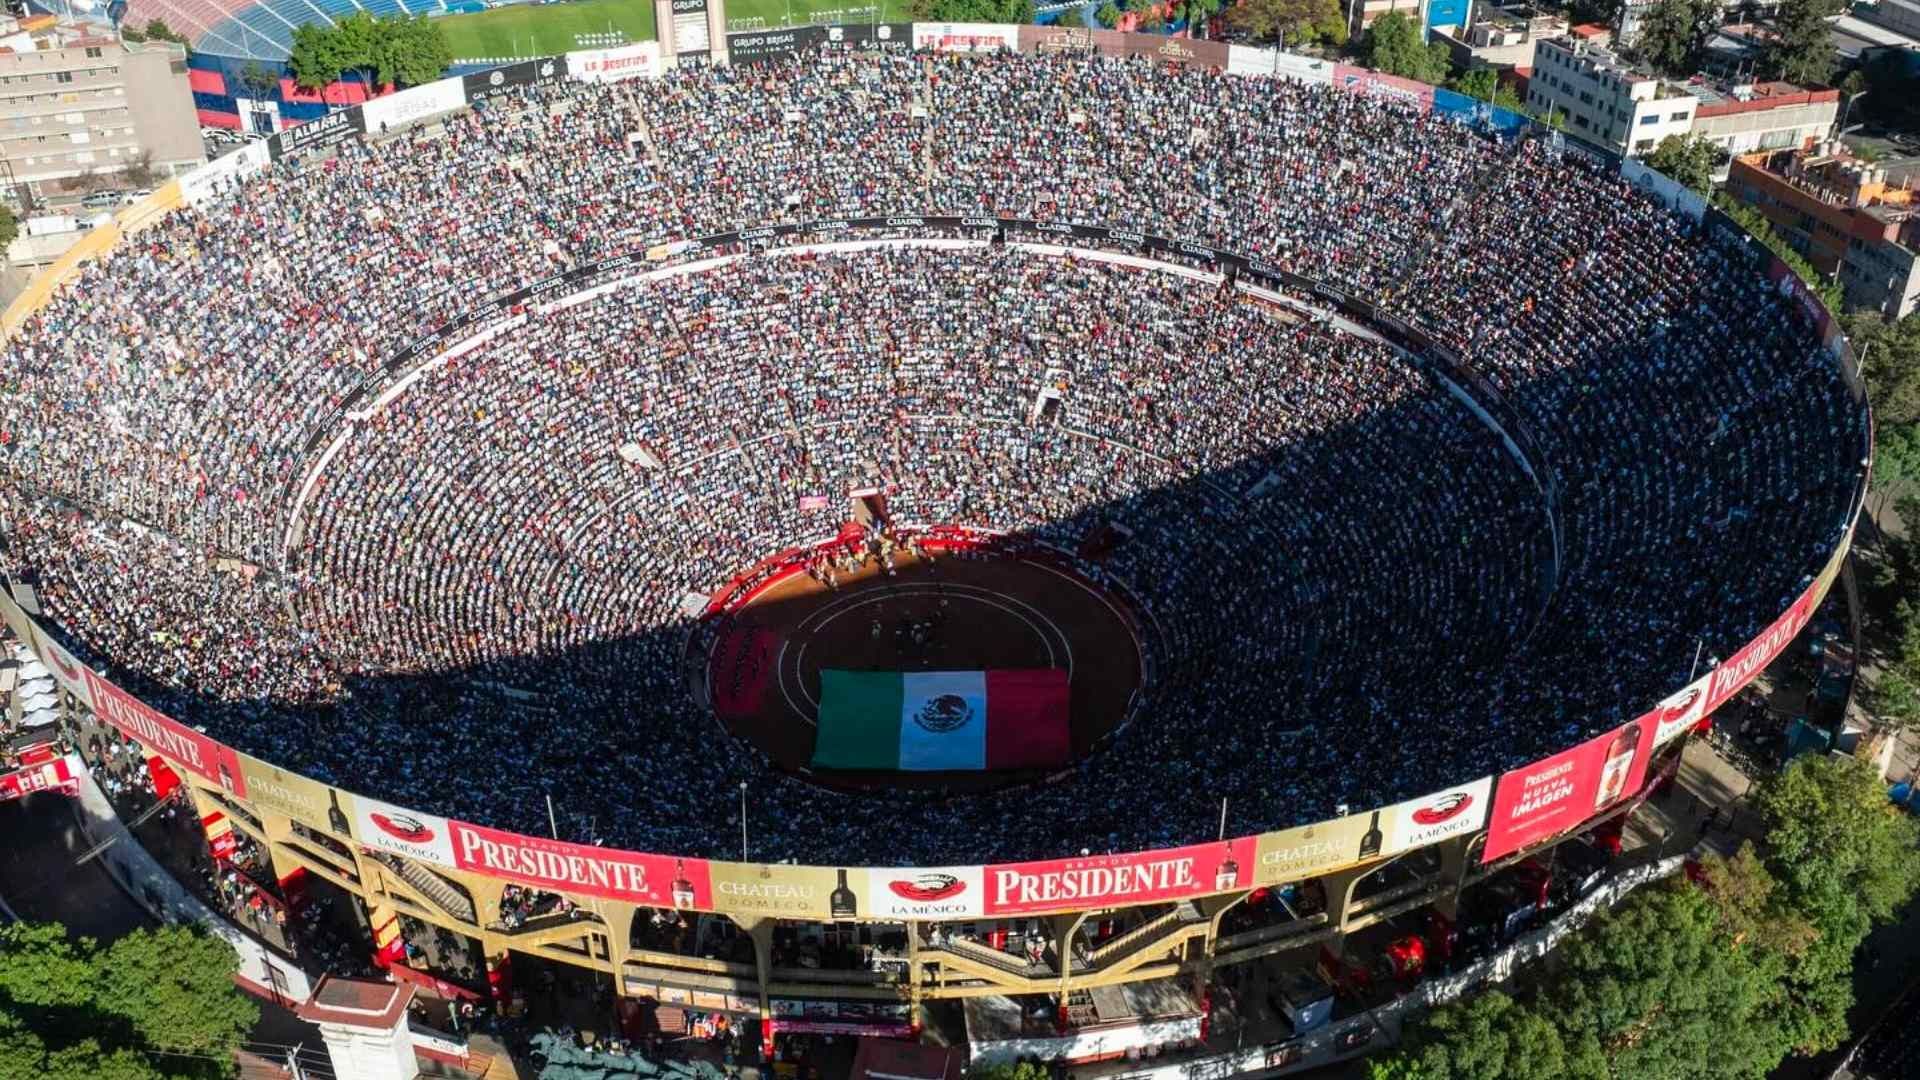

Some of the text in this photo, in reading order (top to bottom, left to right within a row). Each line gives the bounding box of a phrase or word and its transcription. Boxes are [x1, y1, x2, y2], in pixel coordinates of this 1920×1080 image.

[673, 0, 704, 10] GRUPO
[734, 33, 795, 48] GRUPO BRISAS
[294, 111, 350, 140] ALMARA
[886, 218, 925, 227] CUADRA
[91, 677, 204, 769] PRESIDENTE
[1524, 760, 1574, 786] PRESIDENTE
[1511, 784, 1574, 819] IMAGEN
[1522, 778, 1567, 801] NUEVA
[1409, 818, 1470, 845] LA MÉXICO
[376, 837, 440, 861] LA MÉXICO
[458, 827, 648, 893] PRESIDENTE
[1262, 836, 1346, 865] CHATEAU
[1065, 856, 1130, 869] BRANDY
[719, 881, 816, 898] CHATEAU
[994, 857, 1195, 905] PRESIDENTE
[891, 903, 967, 915] LA MÉXICO
